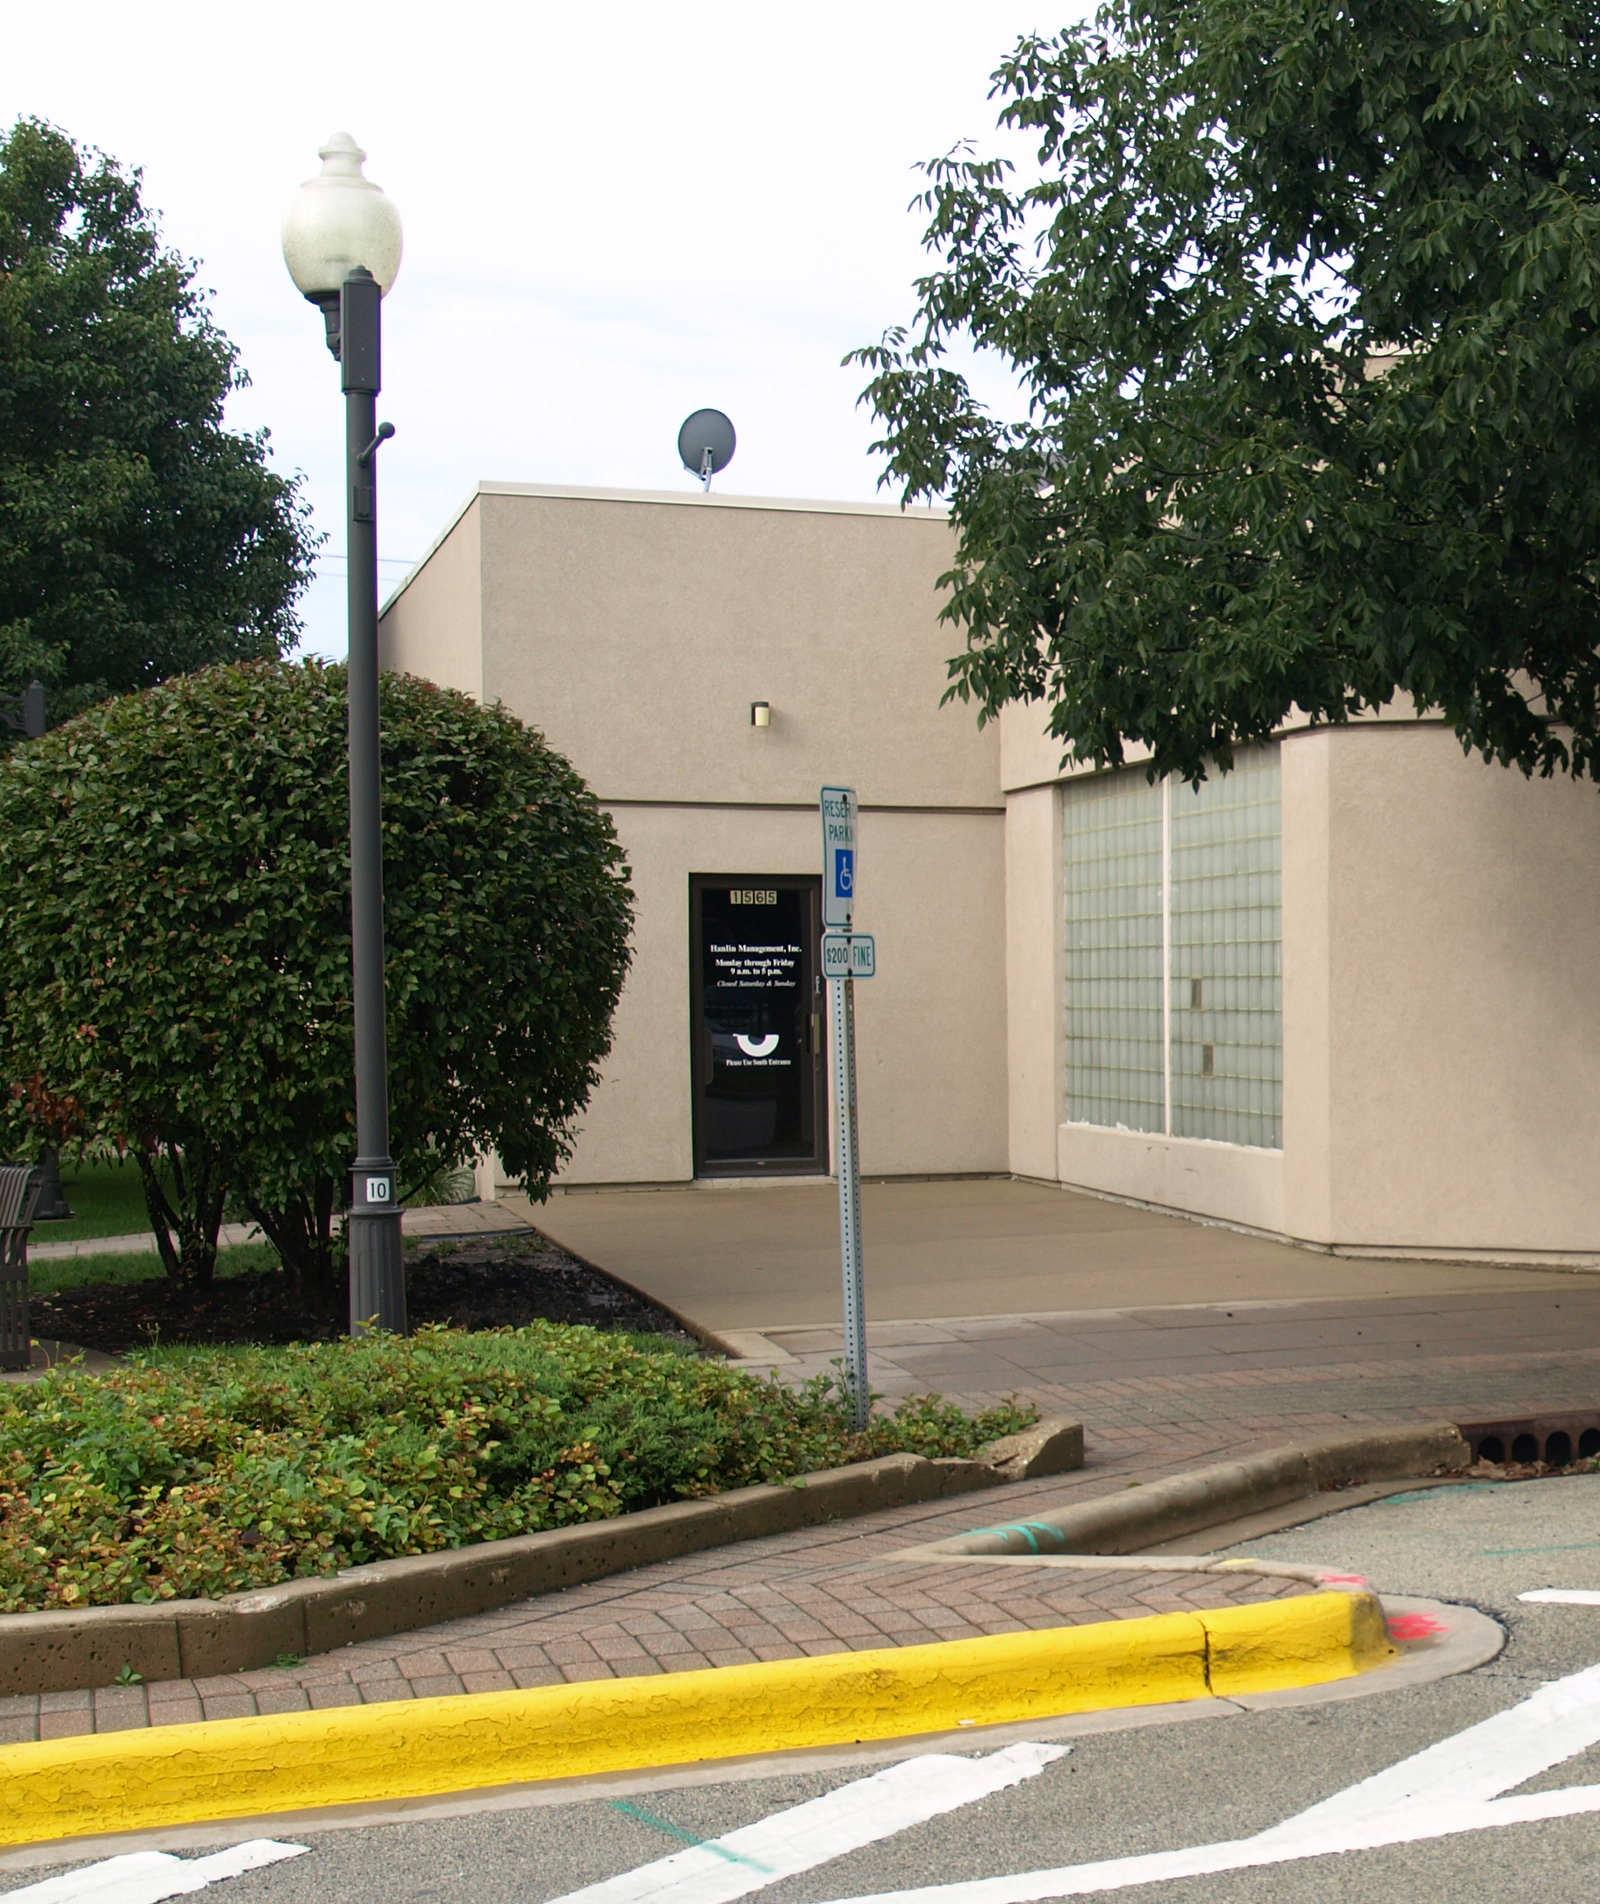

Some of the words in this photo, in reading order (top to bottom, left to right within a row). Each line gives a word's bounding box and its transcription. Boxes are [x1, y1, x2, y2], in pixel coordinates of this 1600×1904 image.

[731, 890, 777, 904] 1565
[710, 944, 737, 953] Hanlin
[827, 946, 848, 964] $200
[853, 945, 872, 967] FINE
[715, 958, 742, 968] Monday
[743, 958, 772, 968] through
[772, 958, 796, 969] Friday
[752, 967, 760, 975] to
[371, 1182, 386, 1199] 10
